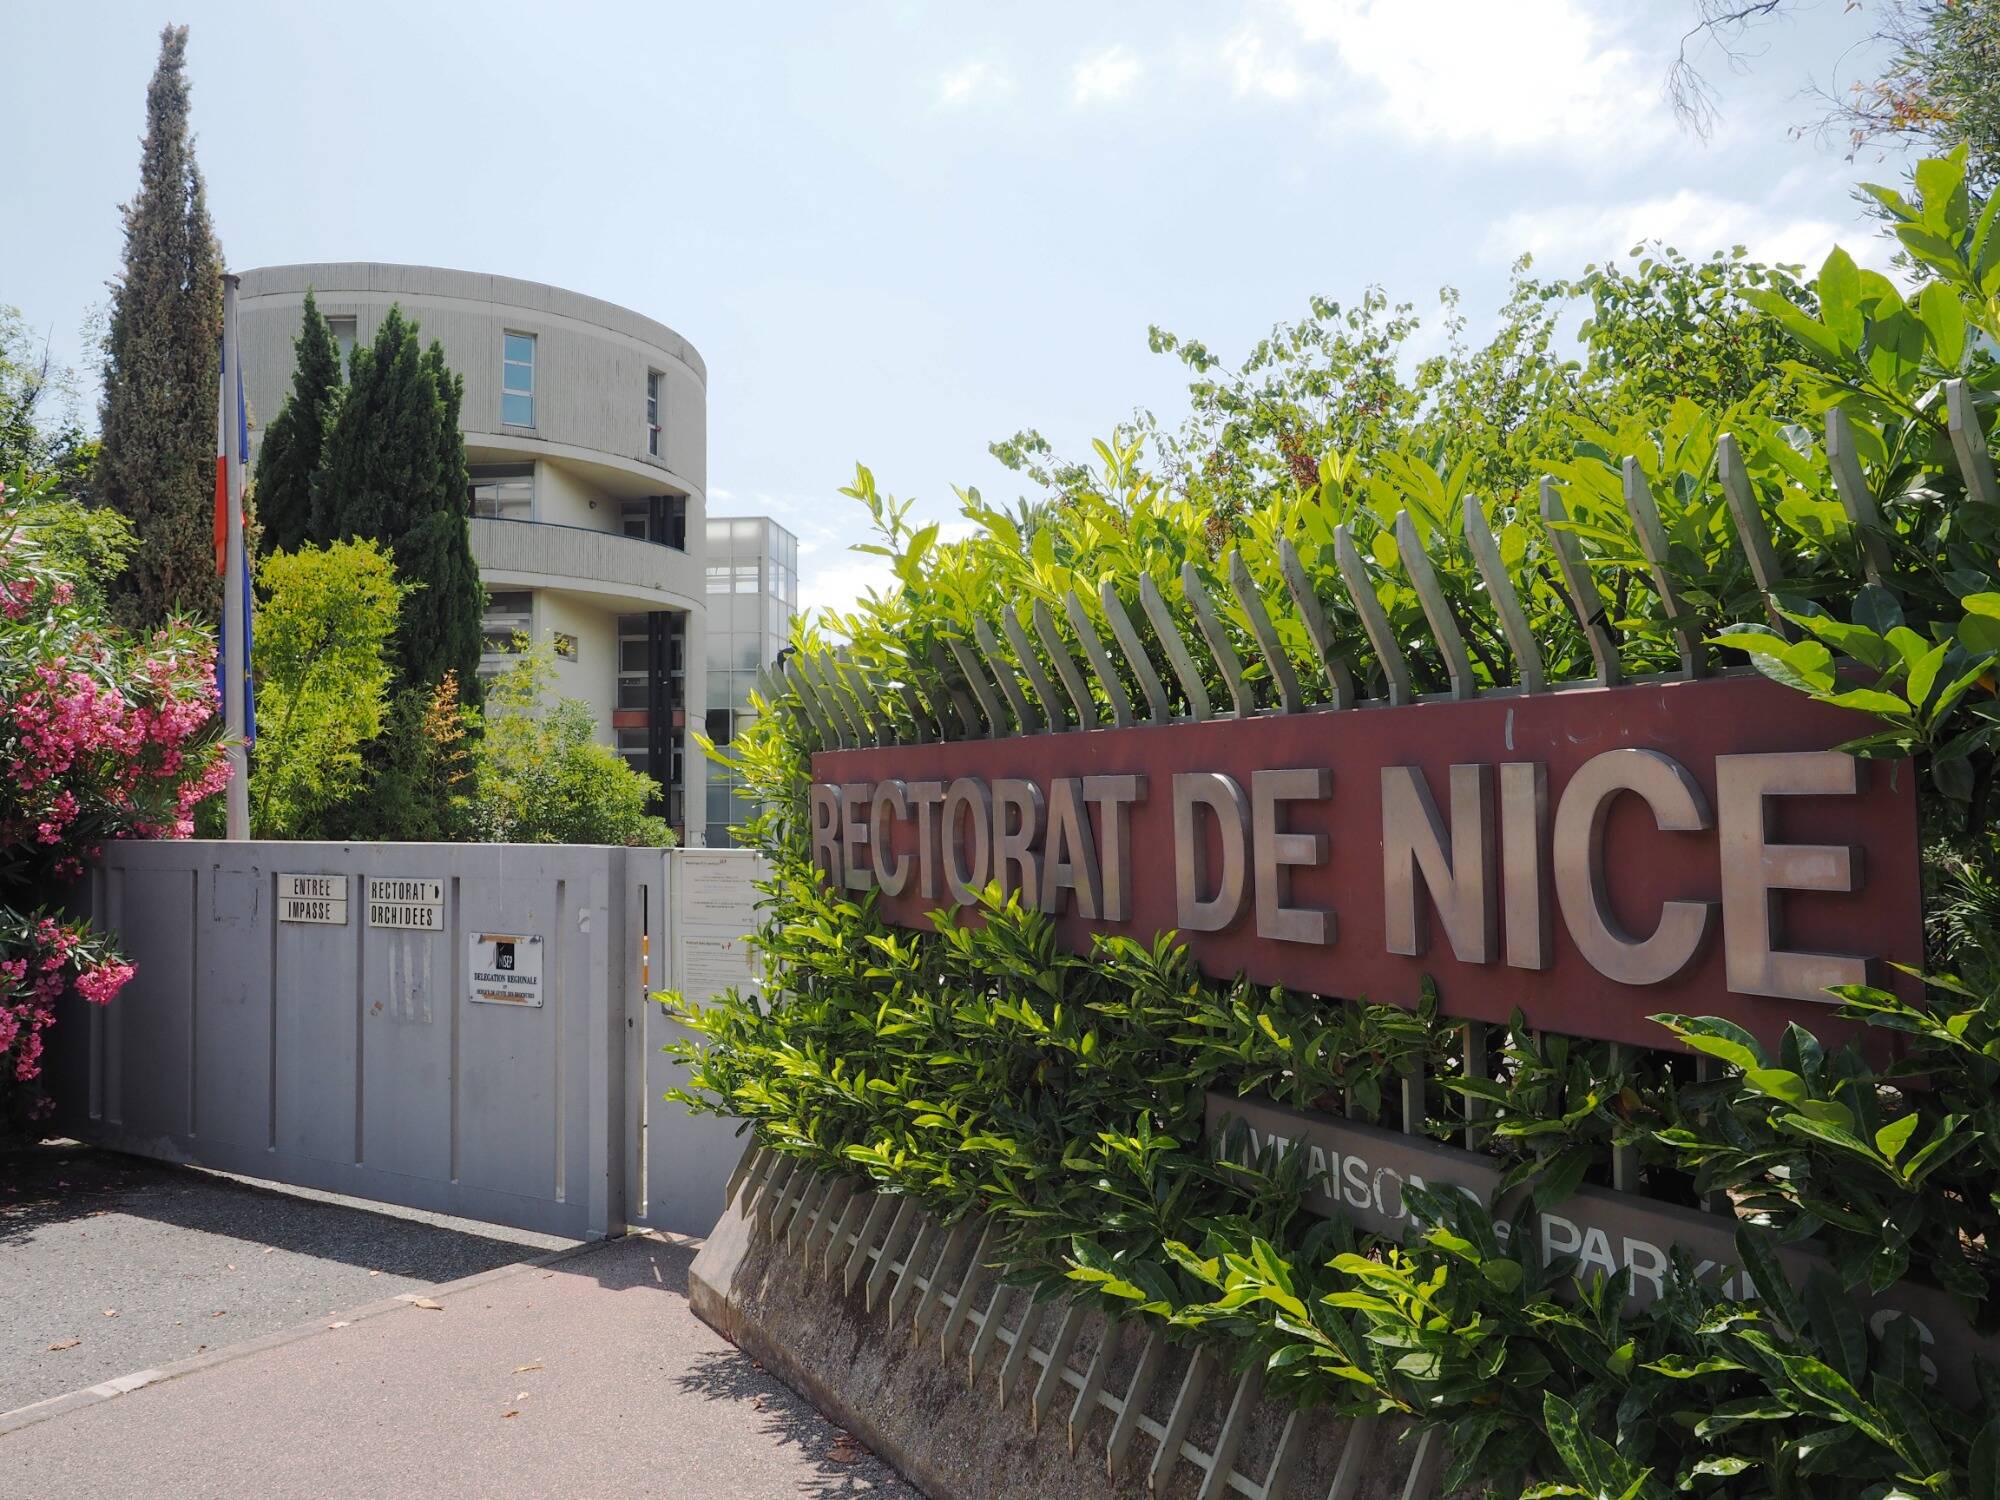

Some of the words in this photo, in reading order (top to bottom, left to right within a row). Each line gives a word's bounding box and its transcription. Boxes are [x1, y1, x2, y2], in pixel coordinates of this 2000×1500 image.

[811, 775, 1147, 922] RECTORAT
[1172, 768, 1337, 945] DE
[1381, 748, 1878, 1004] NICE
[294, 878, 331, 897] ENTREE
[372, 882, 426, 901] RECTORAT
[288, 901, 331, 920] IMPASSE
[371, 905, 433, 927] ORCHIDEES
